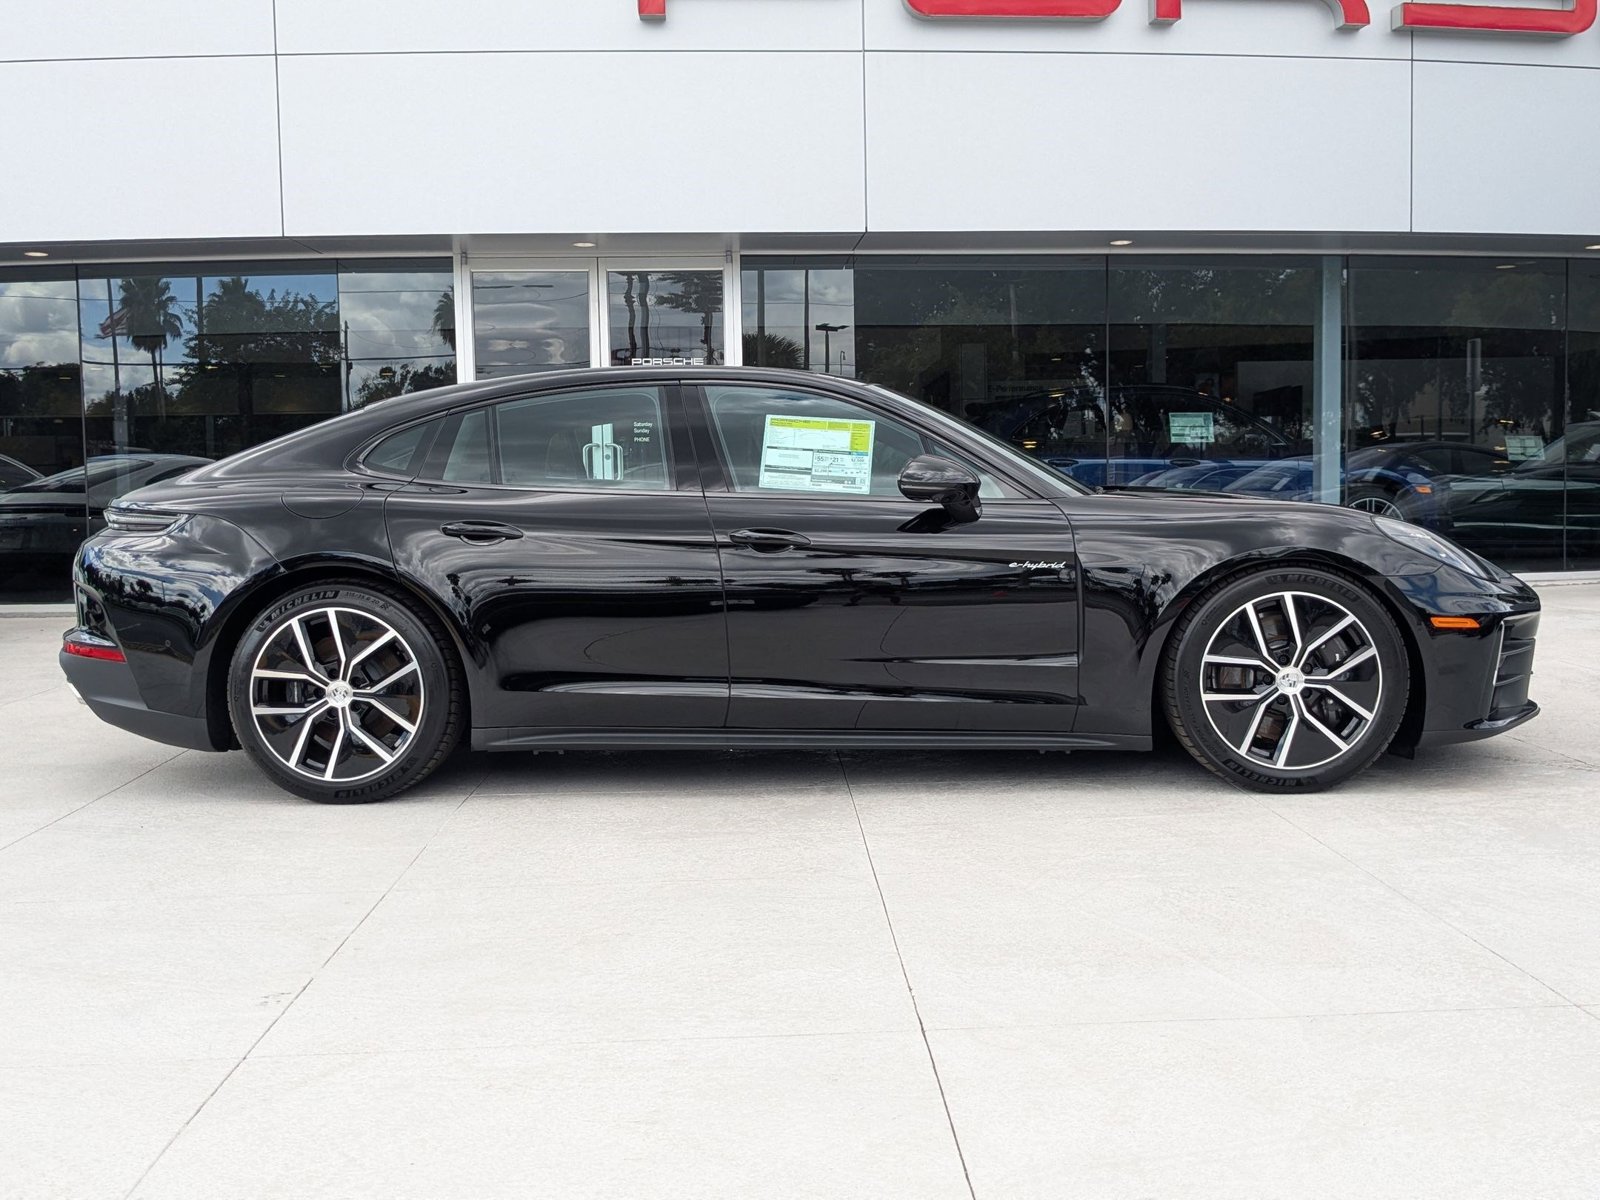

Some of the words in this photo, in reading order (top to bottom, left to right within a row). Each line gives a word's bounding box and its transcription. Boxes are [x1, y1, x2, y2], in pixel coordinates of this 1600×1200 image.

[631, 358, 704, 366] PORSCHE
[1008, 560, 1067, 571] e-hybrid
[1286, 574, 1358, 602] MICHELIN
[271, 590, 335, 620] MICHELIN
[1226, 760, 1297, 787] MICHELIN
